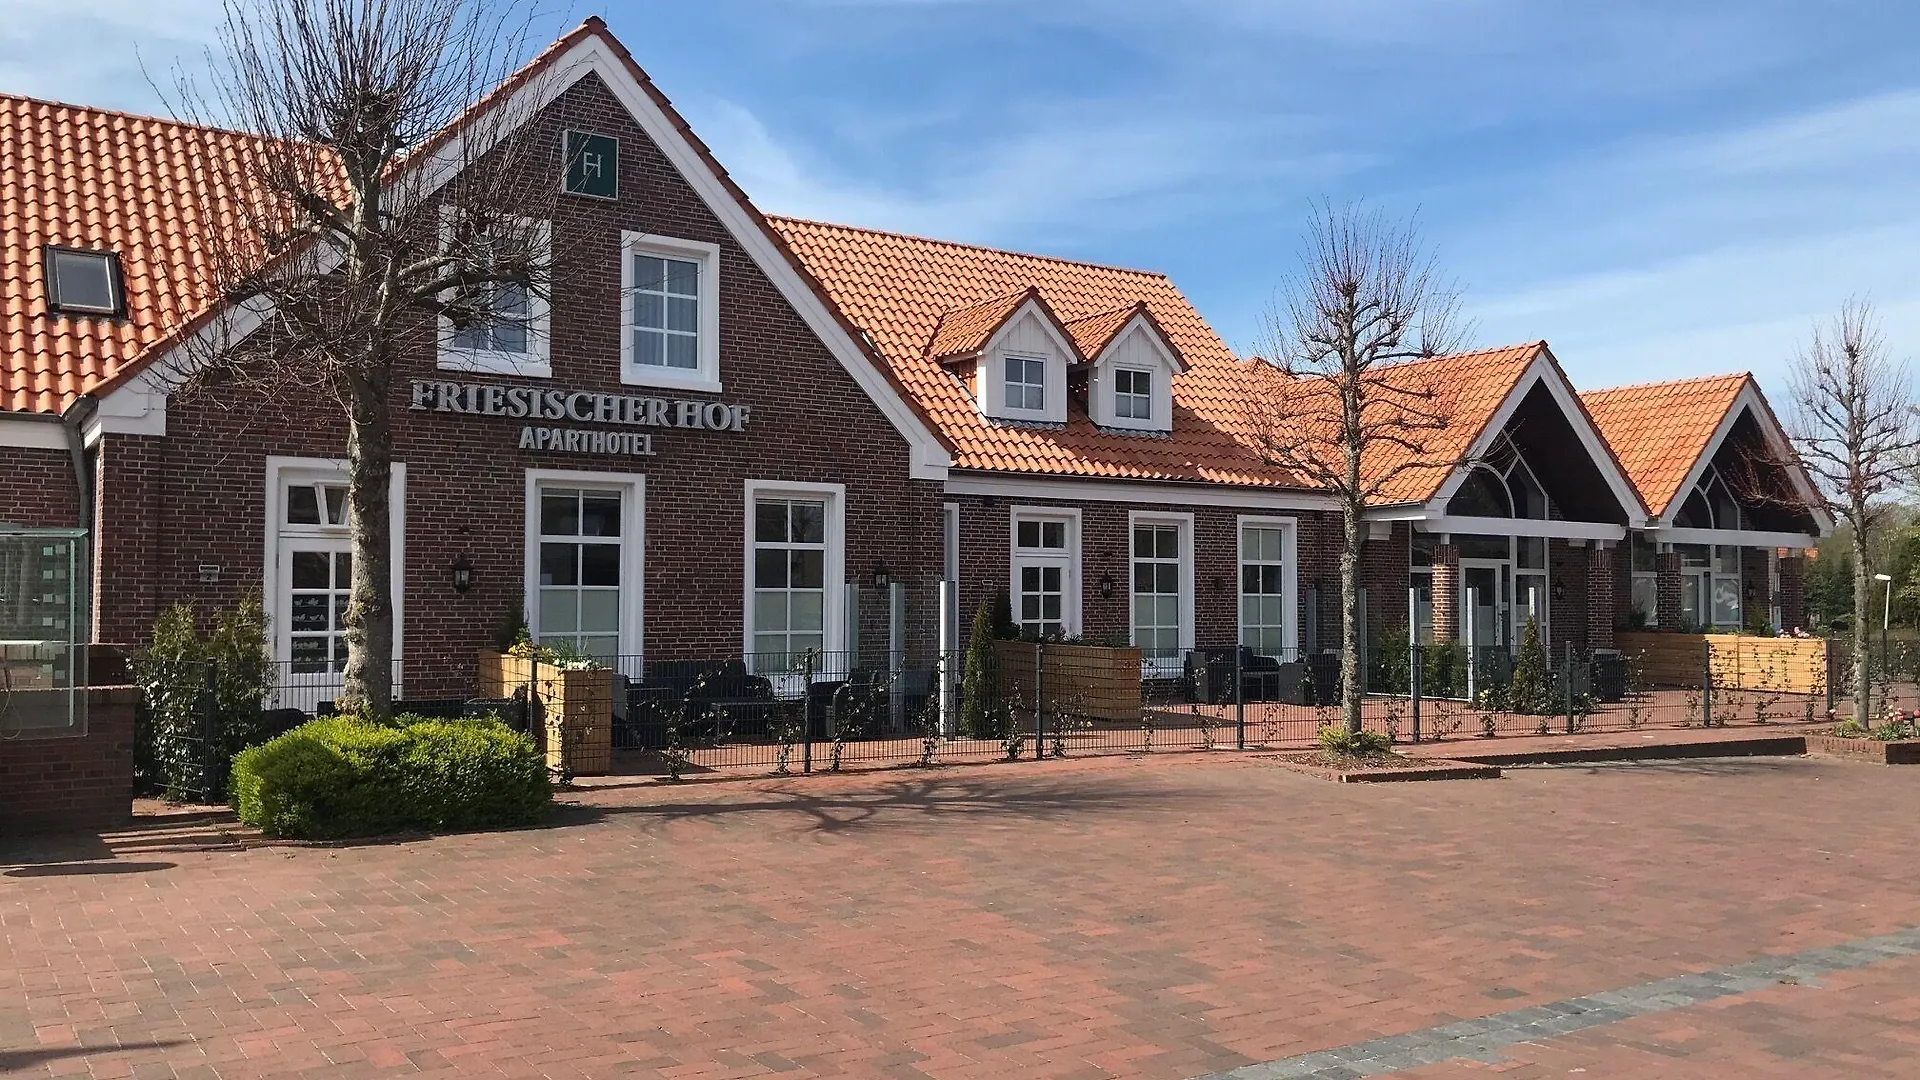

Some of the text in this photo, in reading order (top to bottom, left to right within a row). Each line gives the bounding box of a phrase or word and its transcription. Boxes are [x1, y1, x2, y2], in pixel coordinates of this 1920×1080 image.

[409, 379, 750, 432] FRIESISCHER HOF
[519, 427, 657, 456] APARTHOTEL
